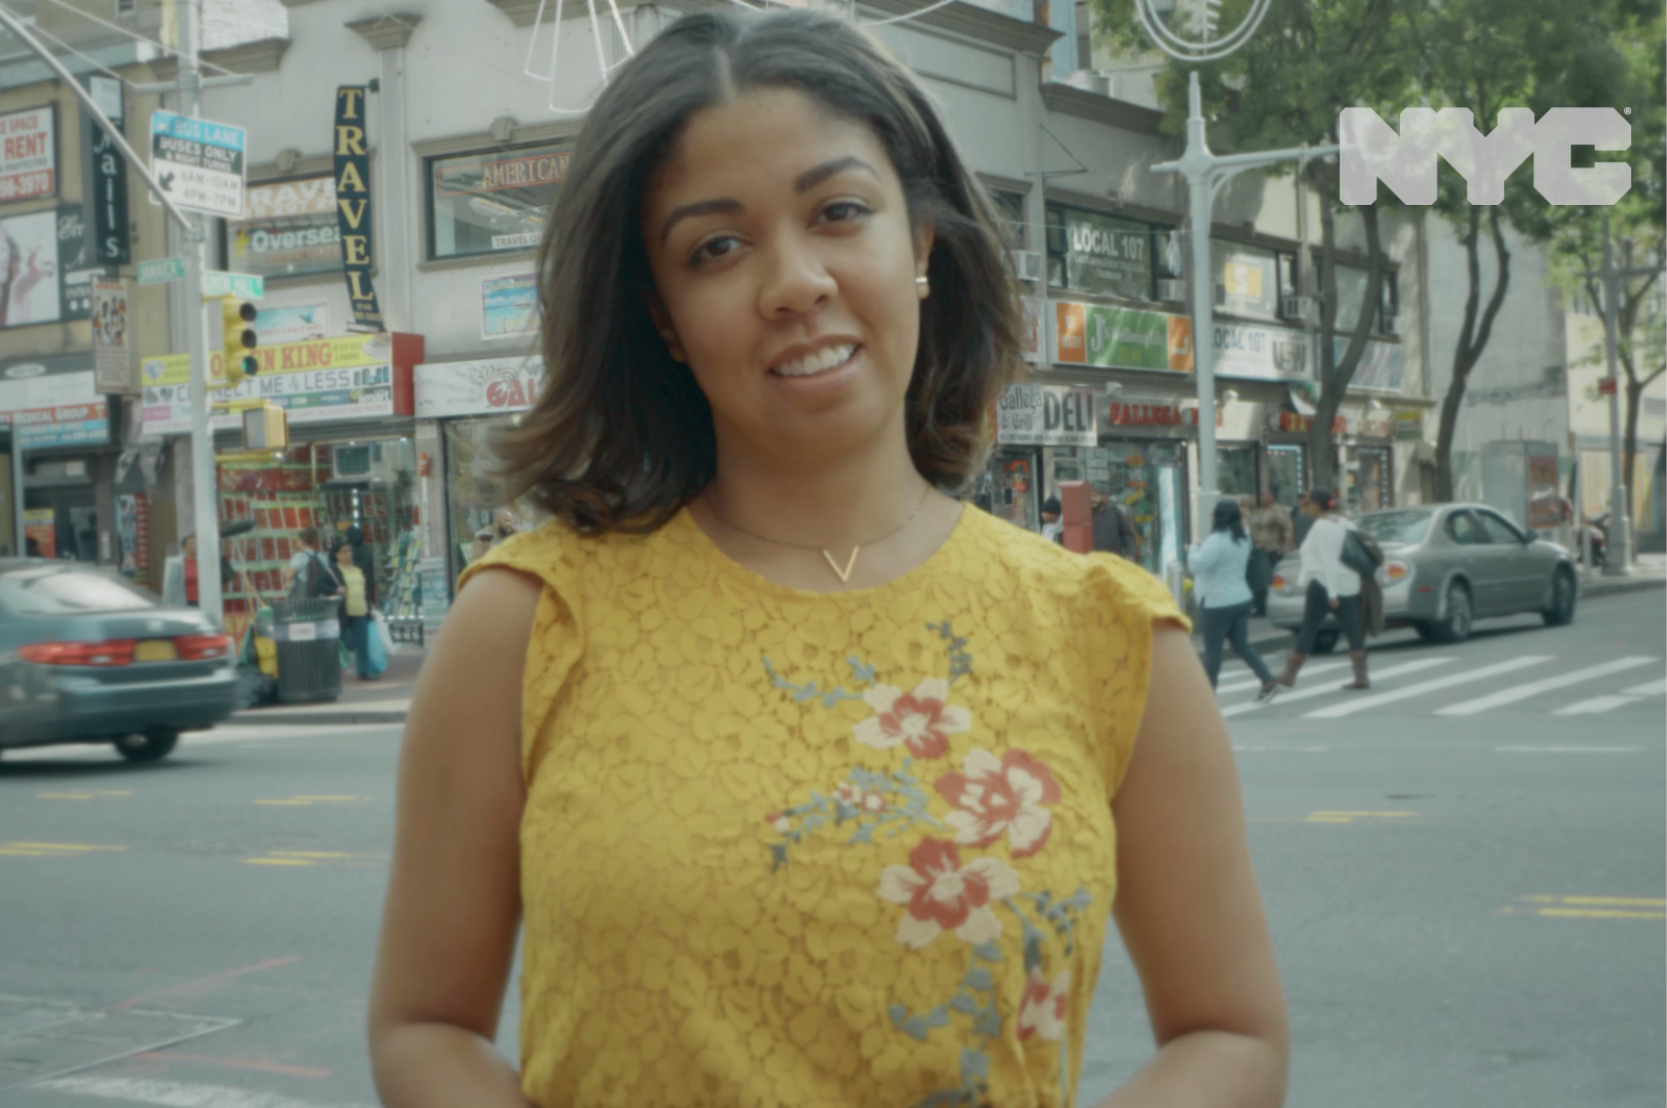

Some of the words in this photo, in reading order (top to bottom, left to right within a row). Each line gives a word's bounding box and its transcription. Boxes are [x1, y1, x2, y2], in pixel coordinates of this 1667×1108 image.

[9, 114, 38, 132] SPACE
[175, 118, 200, 138] BUS
[205, 126, 239, 146] LANE
[5, 131, 47, 160] RENT
[160, 136, 201, 155] BUSES
[205, 145, 237, 163] ONLY
[174, 153, 200, 166] RIGHT
[202, 159, 232, 171] TURNS
[335, 88, 375, 301] TRAVEL
[495, 234, 528, 247] TRAVEL
[1073, 226, 1119, 257] LOCAL
[1121, 234, 1144, 260] 107
[1248, 331, 1266, 352] 107
[281, 343, 331, 371] KING
[260, 376, 282, 395] ME
[305, 370, 349, 391] LESS
[55, 406, 89, 421] GROUP
[1012, 413, 1033, 430] Grill
[1043, 391, 1094, 431] DELI
